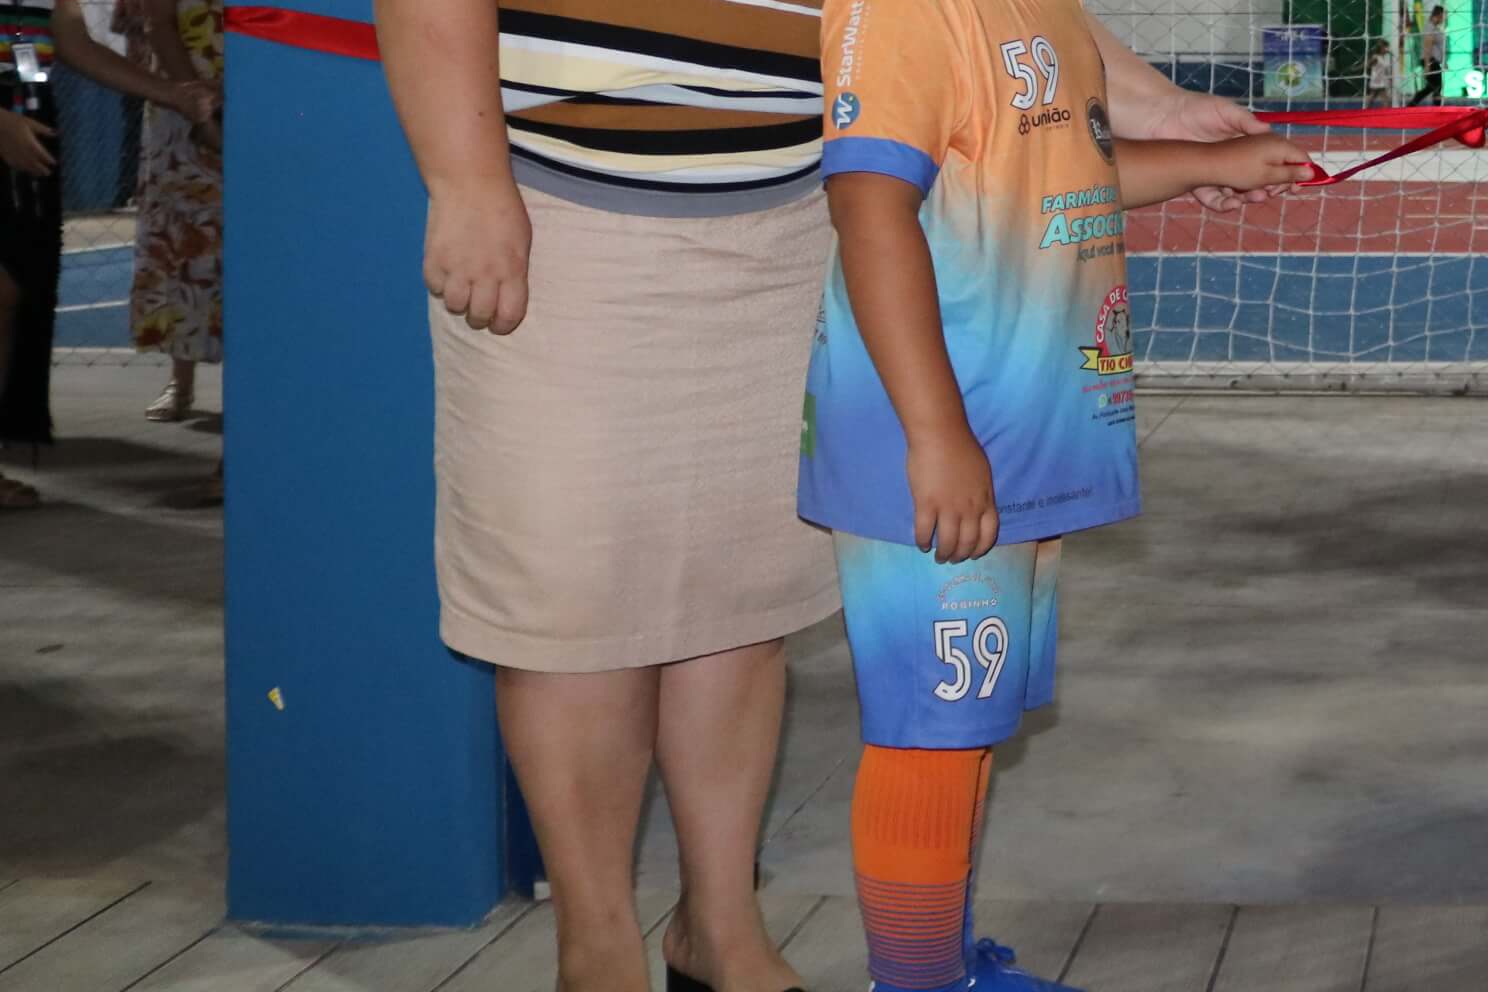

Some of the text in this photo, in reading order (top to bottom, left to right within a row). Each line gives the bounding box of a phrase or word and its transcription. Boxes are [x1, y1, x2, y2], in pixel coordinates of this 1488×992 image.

[836, 0, 866, 88] StarWatt
[1000, 35, 1059, 110] 59
[1031, 107, 1072, 128] união
[1100, 358, 1116, 373] TIO
[932, 616, 1009, 701] 59
